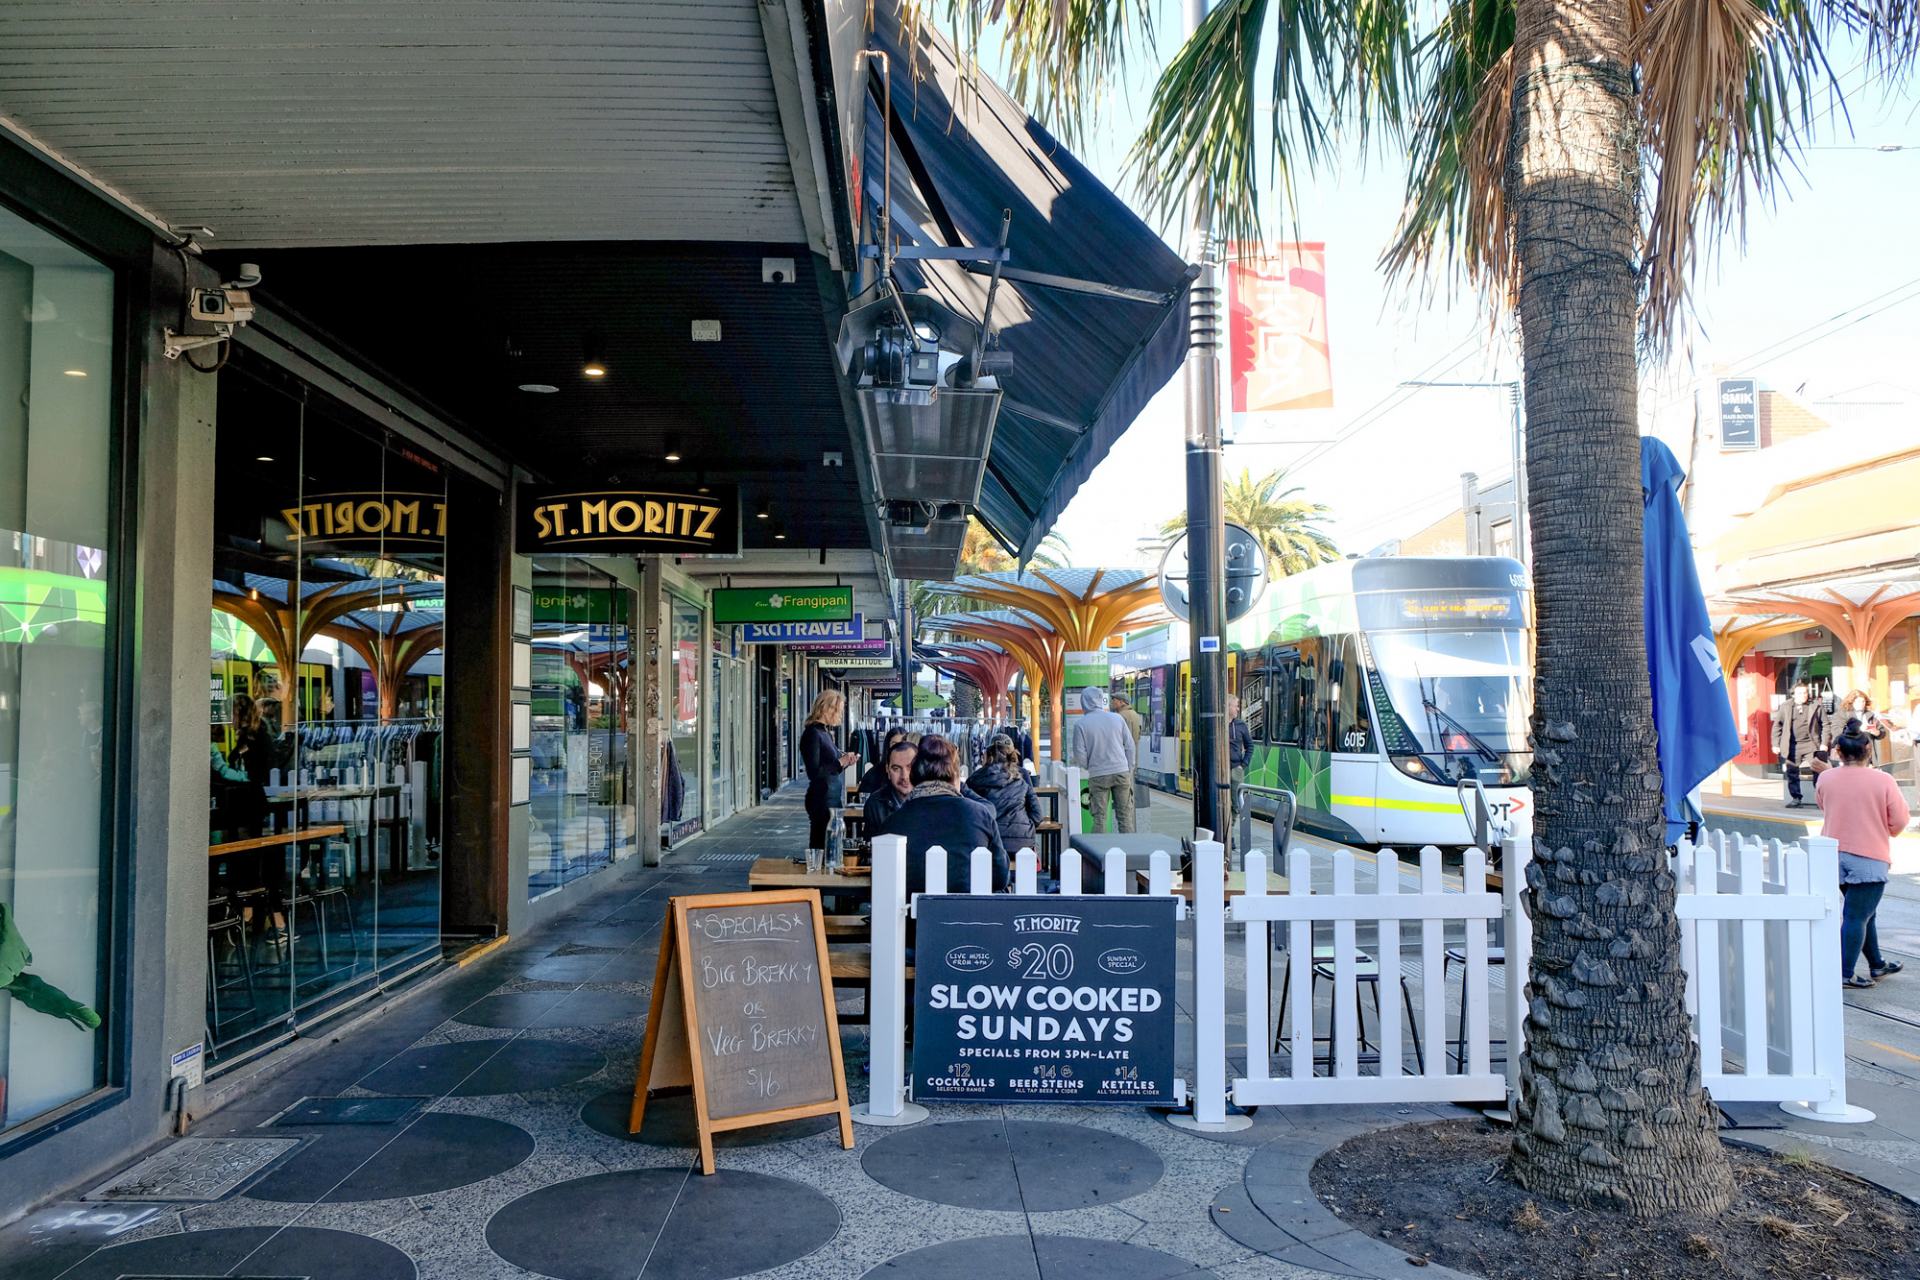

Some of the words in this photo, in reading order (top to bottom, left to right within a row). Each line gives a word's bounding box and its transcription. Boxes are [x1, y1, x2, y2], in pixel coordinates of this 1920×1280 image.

[1722, 393, 1753, 405] SMIK
[784, 595, 847, 609] Frangipani
[782, 621, 854, 636] TRAVEL
[1344, 732, 1366, 748] 6015
[1007, 943, 1074, 980] $20
[929, 984, 1022, 1010] SLOW
[1026, 986, 1162, 1013] COOKED
[956, 1014, 1134, 1042] SUNDAYS
[959, 1048, 1020, 1058] SPECIALS
[1025, 1049, 1060, 1059] FROM
[948, 1063, 971, 1078] $12
[1033, 1065, 1056, 1079] $14
[1115, 1066, 1138, 1080] $14
[927, 1078, 995, 1088] COCKTAILS
[1009, 1079, 1039, 1088] BEER
[1042, 1080, 1084, 1088] STEINS
[1102, 1081, 1155, 1090] KETTLES
